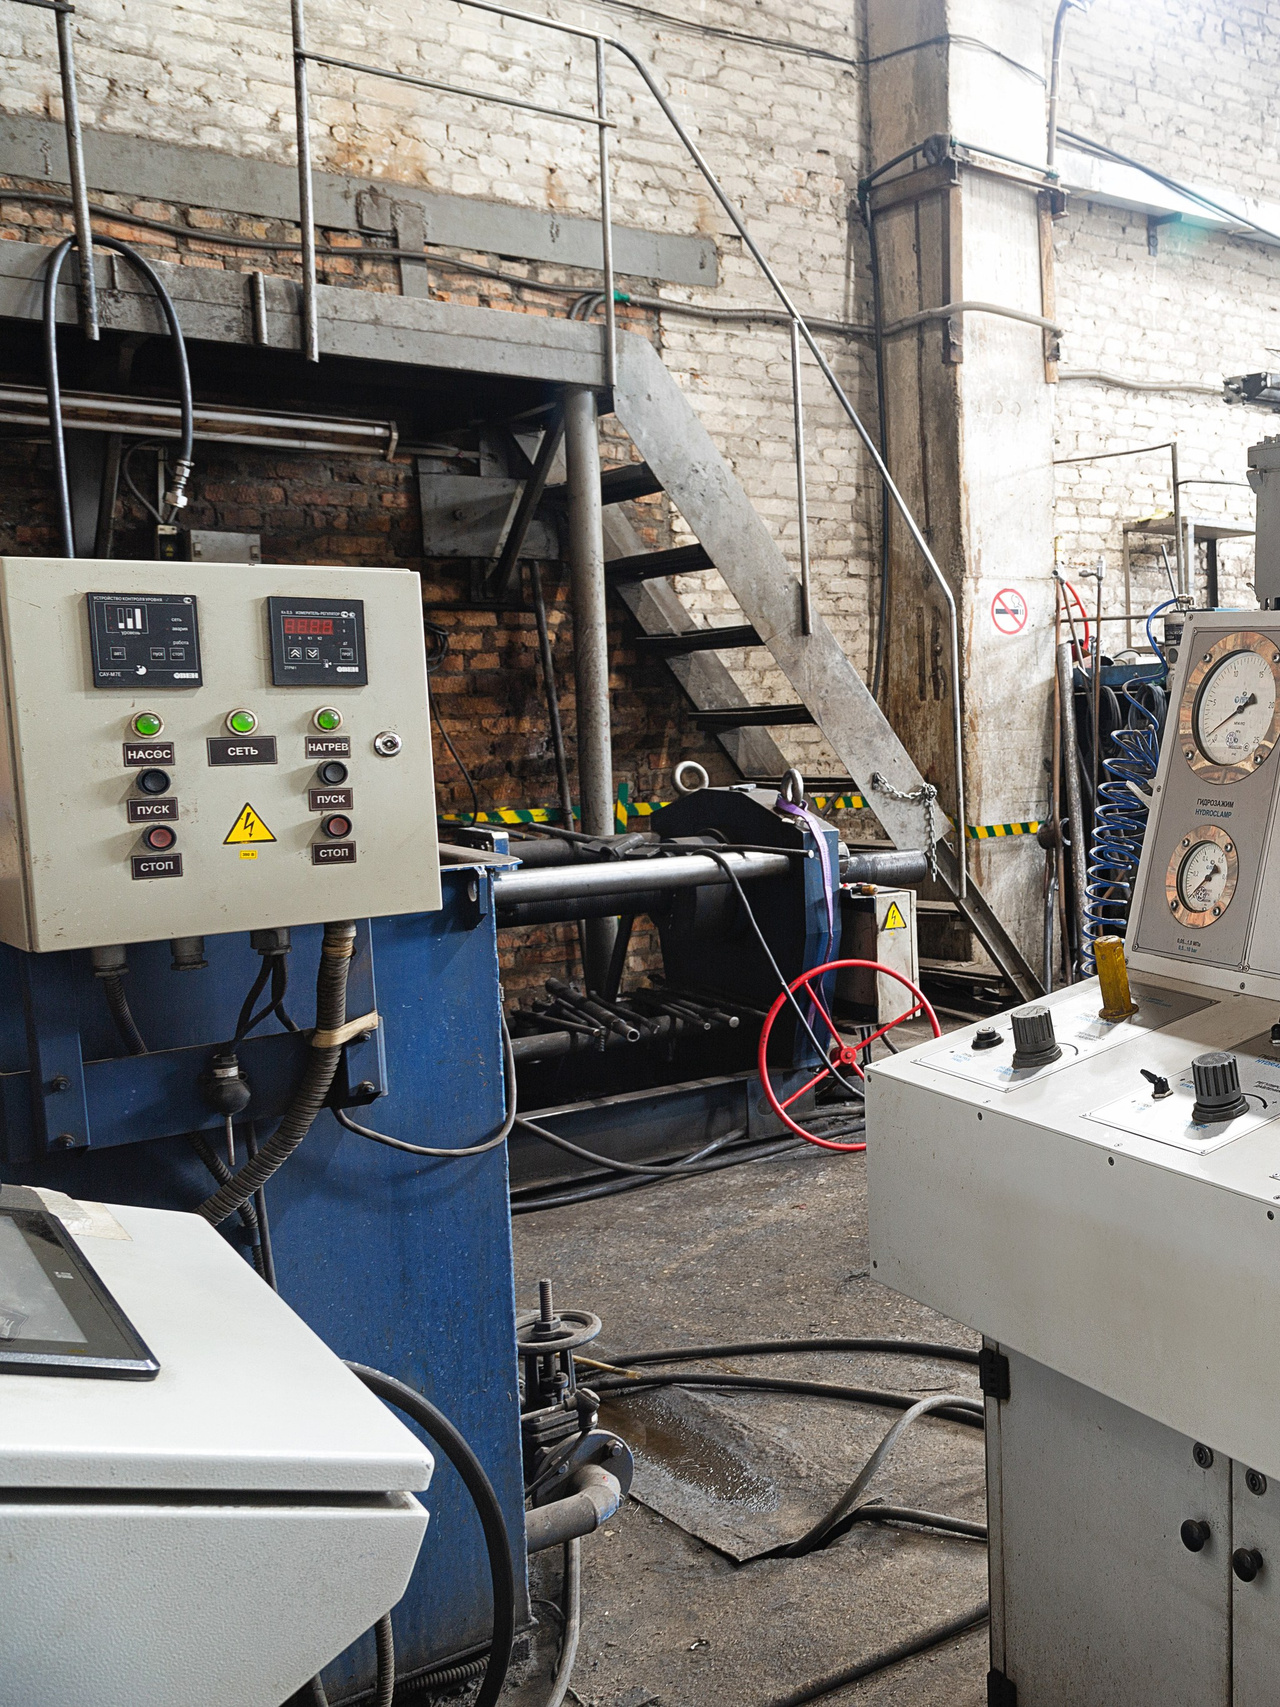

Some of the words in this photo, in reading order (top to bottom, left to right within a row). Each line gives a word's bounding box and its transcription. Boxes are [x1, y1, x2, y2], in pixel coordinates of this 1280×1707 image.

[1233, 670, 1239, 678] 10
[1258, 670, 1264, 679] 15
[1268, 701, 1275, 709] 20
[1252, 736, 1260, 744] 25
[227, 746, 259, 756] СЕТЬ
[308, 742, 349, 752] НАГРЕВ
[128, 750, 172, 760] НАСОС
[316, 794, 346, 804] ПУСК
[1196, 798, 1234, 809] ГИДРОЗАЖИМ
[136, 805, 170, 816] ПУСК
[1194, 808, 1232, 818] HYDROCLAMP
[318, 848, 349, 858] СТОП
[140, 861, 174, 872] СТОП
